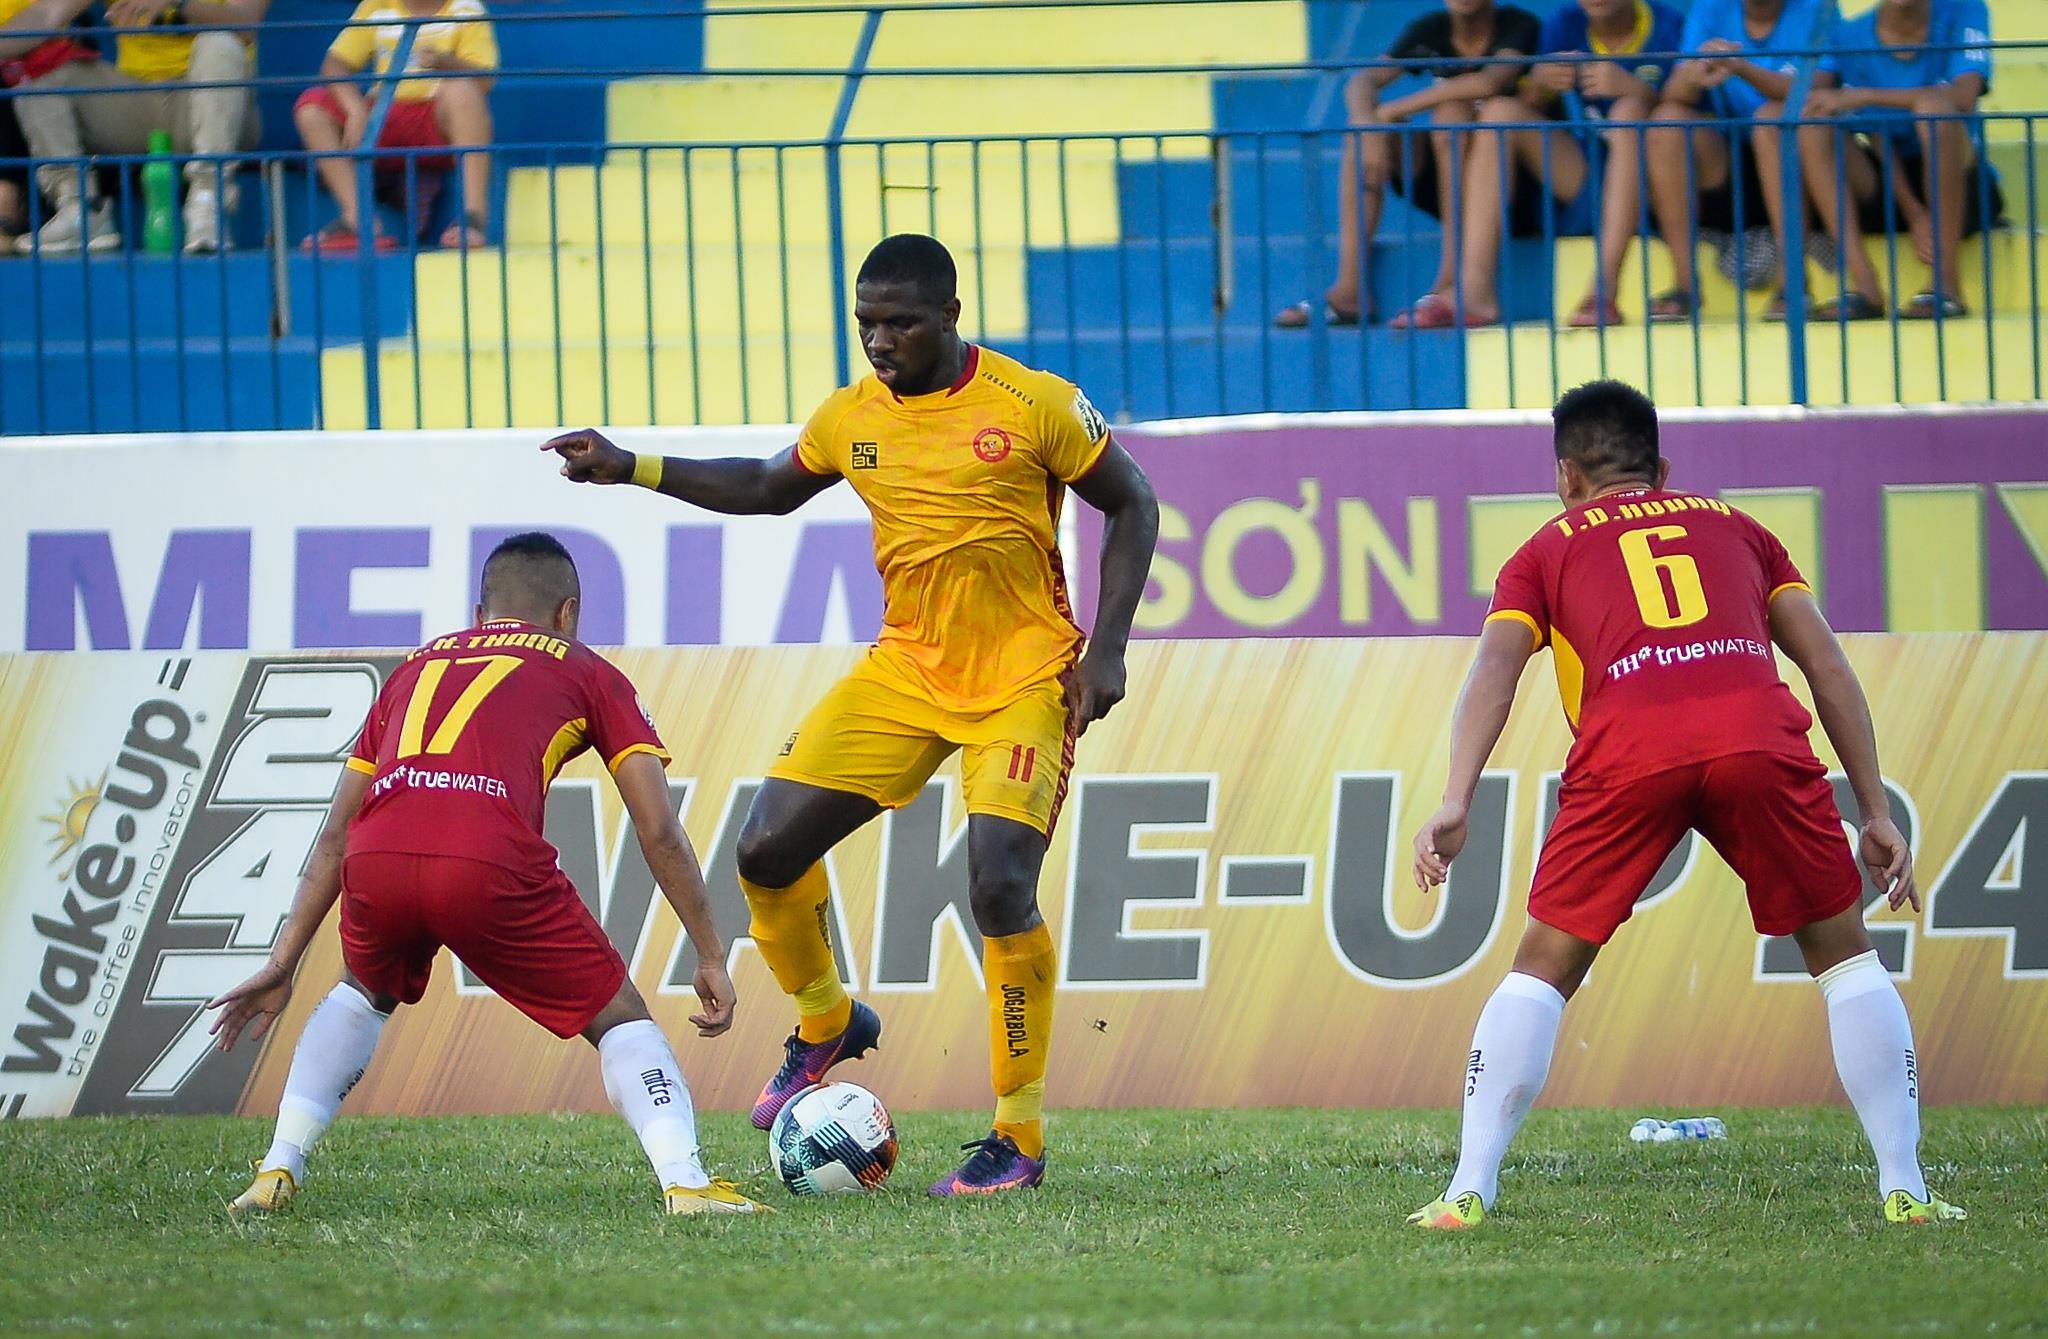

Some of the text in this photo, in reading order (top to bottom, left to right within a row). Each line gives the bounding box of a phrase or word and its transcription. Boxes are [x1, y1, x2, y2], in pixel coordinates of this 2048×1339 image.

[26, 523, 884, 651] MEDIA
[1618, 524, 1710, 629] 6
[397, 655, 524, 759] 17
[1007, 743, 1036, 783] 11
[67, 771, 199, 1077] the coffee innovator
[1001, 984, 1030, 1058] JOGARBOLA
